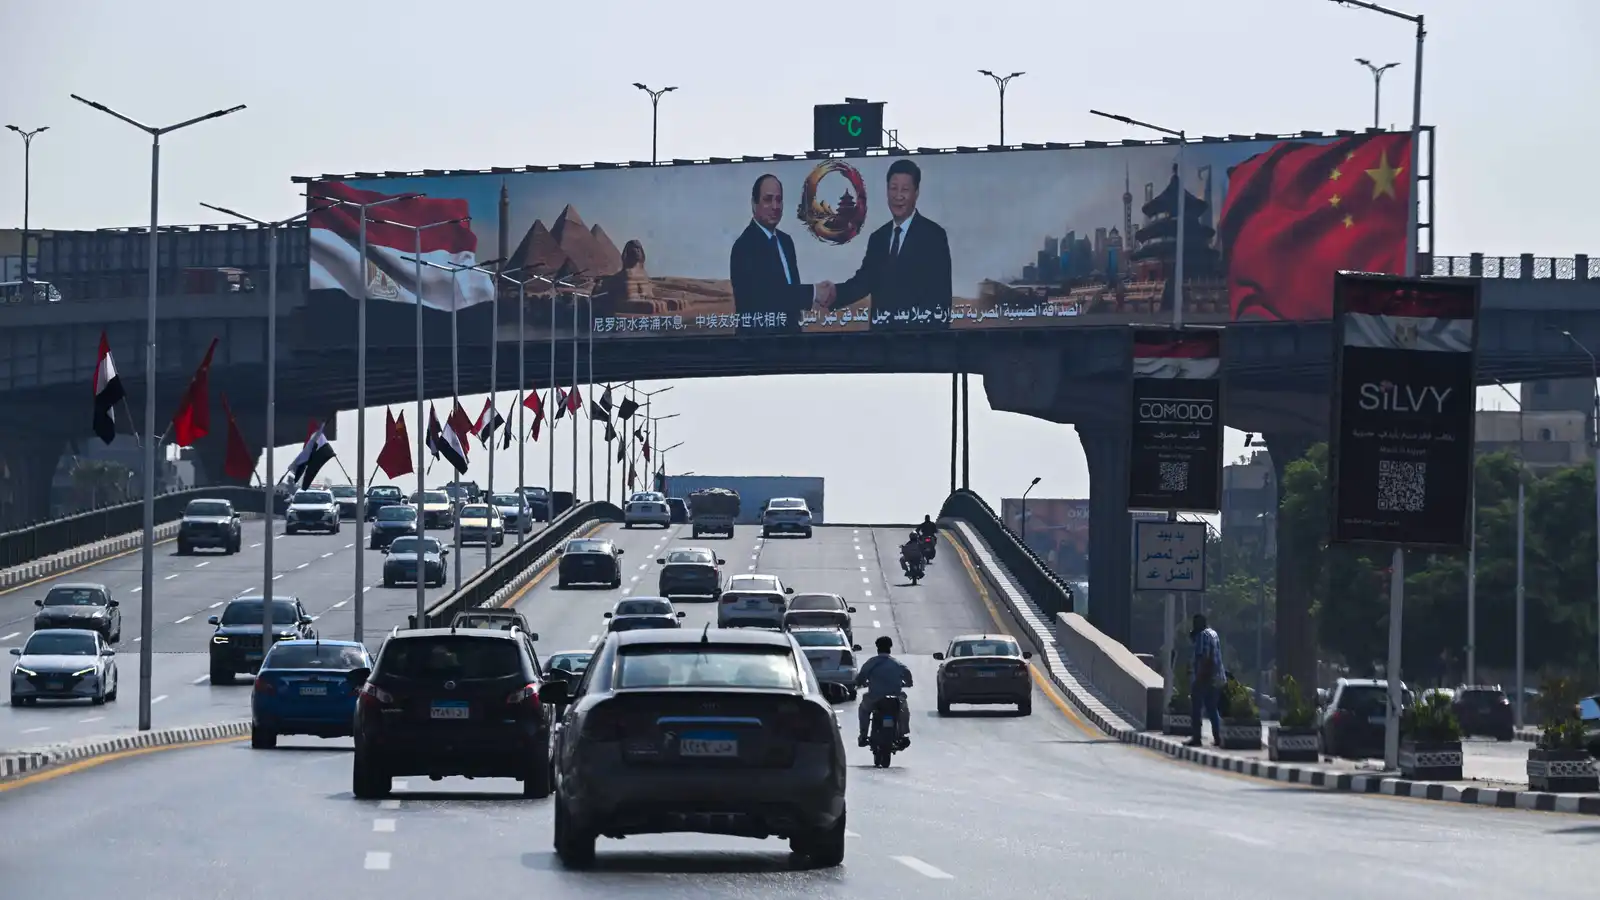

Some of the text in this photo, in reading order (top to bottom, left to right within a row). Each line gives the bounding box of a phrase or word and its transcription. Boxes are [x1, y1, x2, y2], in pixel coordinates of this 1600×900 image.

[839, 115, 862, 137] °C
[798, 307, 821, 327] النيل
[821, 308, 838, 329] نهر
[839, 306, 869, 326] كتدفق
[872, 307, 891, 325] جيل
[894, 310, 910, 324] بعد
[934, 303, 965, 323] تتوارث
[966, 303, 1002, 323] المصرية
[1004, 303, 1041, 321] الصينية
[1042, 301, 1082, 318] الصداقة
[1140, 403, 1213, 419] COMODO
[1142, 548, 1173, 562] لمصر
[1146, 567, 1161, 578] غد
